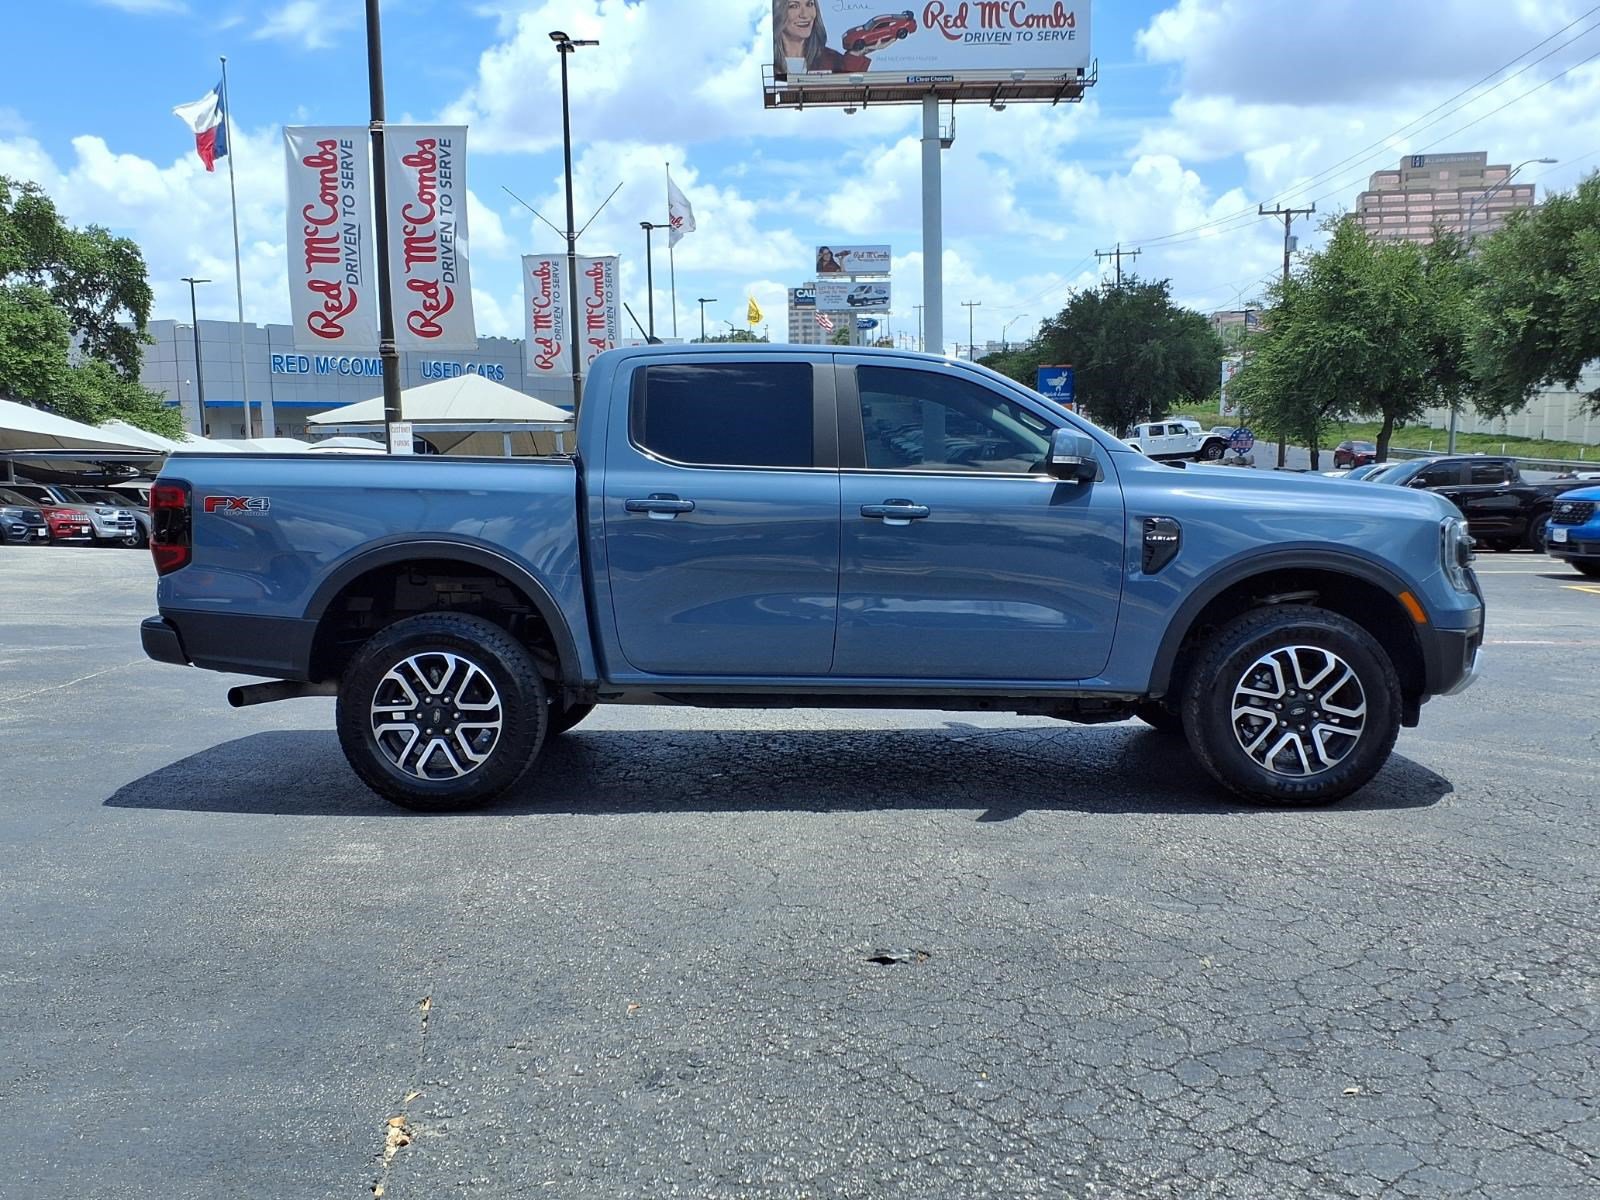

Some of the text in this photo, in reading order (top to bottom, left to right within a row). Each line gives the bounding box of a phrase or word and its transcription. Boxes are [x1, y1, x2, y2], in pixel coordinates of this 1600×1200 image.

[923, 0, 1076, 40] Red McCombs
[964, 30, 1076, 43] DRIVEN TO SERVE
[303, 139, 357, 339] Red McCombs
[340, 139, 360, 286] DRIVEN TO SERVE
[402, 138, 454, 338] Red McCombs
[439, 138, 456, 284] DRIVEN TO SERVE
[532, 261, 561, 370] Red McCombs
[552, 261, 563, 341] DRIVEN TO SERVE
[585, 261, 605, 334] McCombs
[606, 291, 614, 304] TO
[607, 306, 616, 341] DRIVEN
[271, 354, 310, 373] RED
[422, 360, 463, 379] USED
[204, 496, 270, 513] FX4
